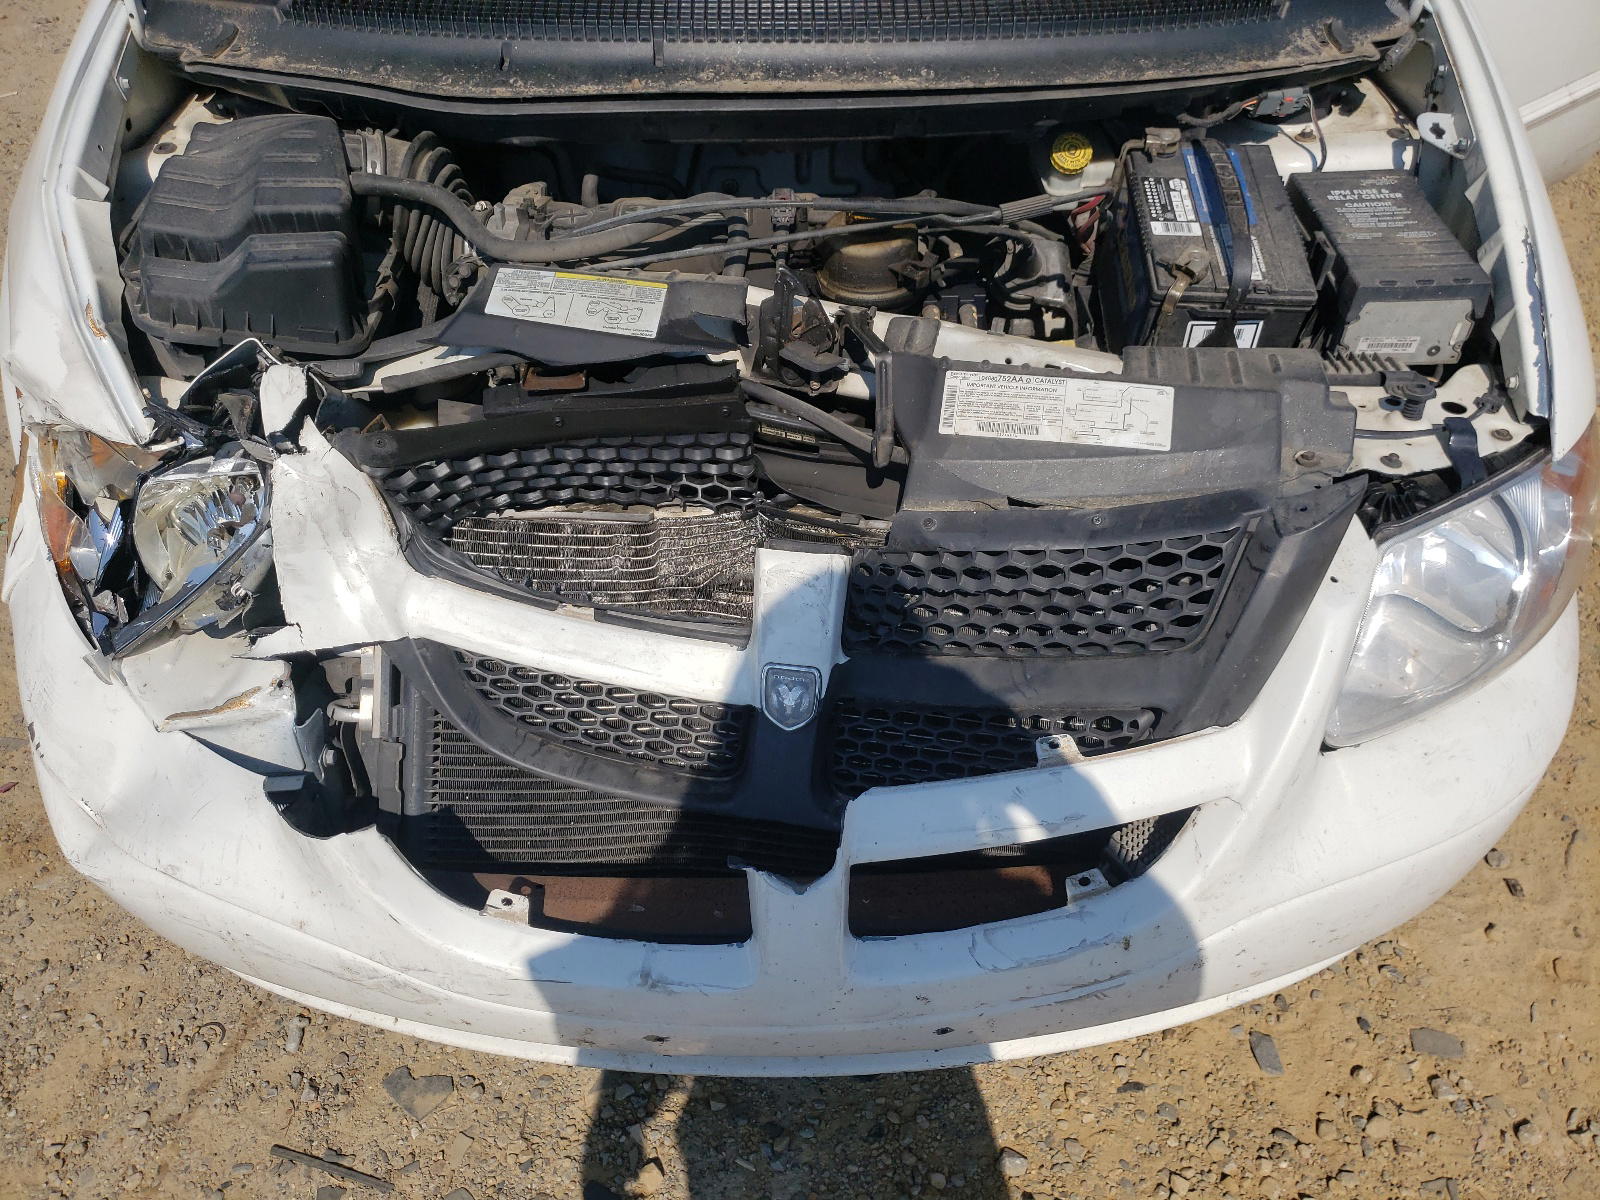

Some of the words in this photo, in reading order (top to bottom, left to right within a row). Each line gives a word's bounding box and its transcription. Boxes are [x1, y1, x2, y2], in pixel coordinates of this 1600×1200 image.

[1352, 188, 1378, 196] FUSE
[1361, 192, 1403, 200] CENTER
[1034, 377, 1066, 385] CATALYST
[966, 381, 997, 389] IMPORTANT
[1019, 385, 1059, 393] INFORMATION
